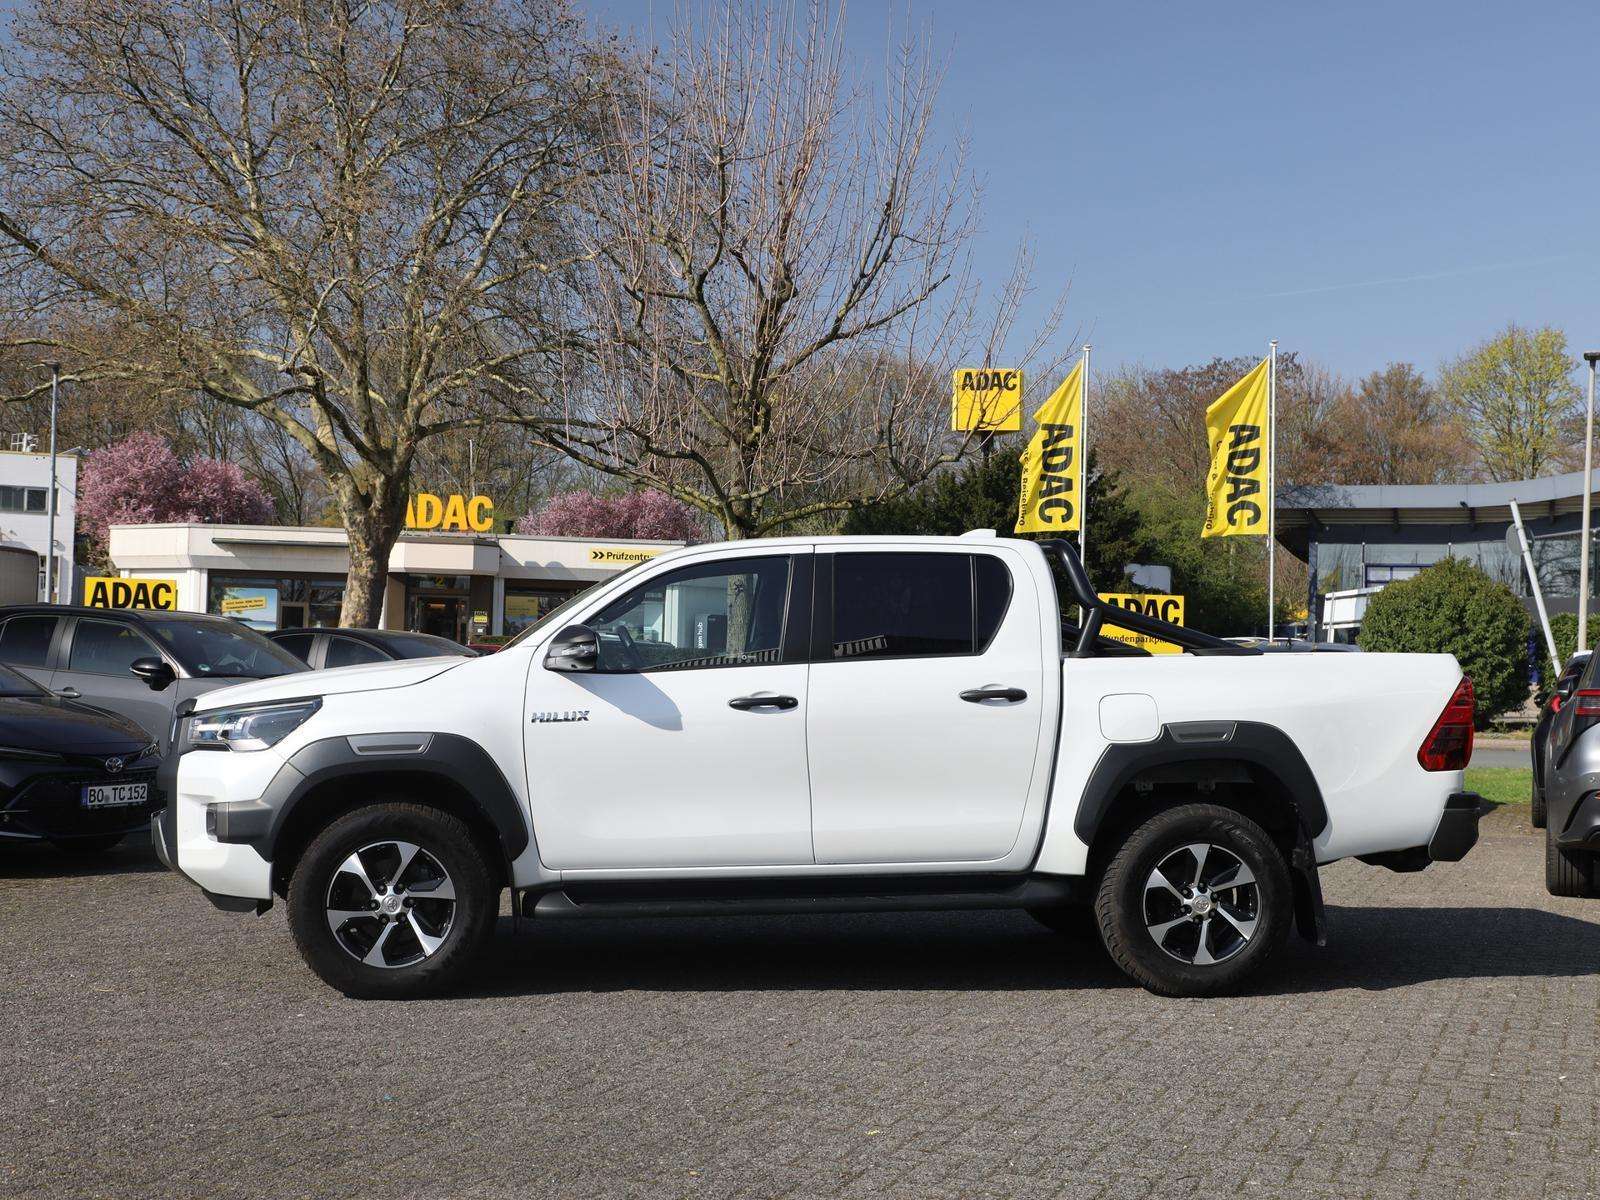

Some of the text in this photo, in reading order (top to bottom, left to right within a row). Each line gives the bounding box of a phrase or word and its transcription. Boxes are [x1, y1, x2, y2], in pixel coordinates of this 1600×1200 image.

[962, 372, 1017, 391] ADAC
[1039, 424, 1074, 524] ADAC
[1227, 425, 1261, 526] ADAC
[606, 551, 653, 561] Prüfzentr
[90, 581, 172, 609] ADAC
[531, 710, 590, 723] HILUX
[89, 788, 104, 803] BO
